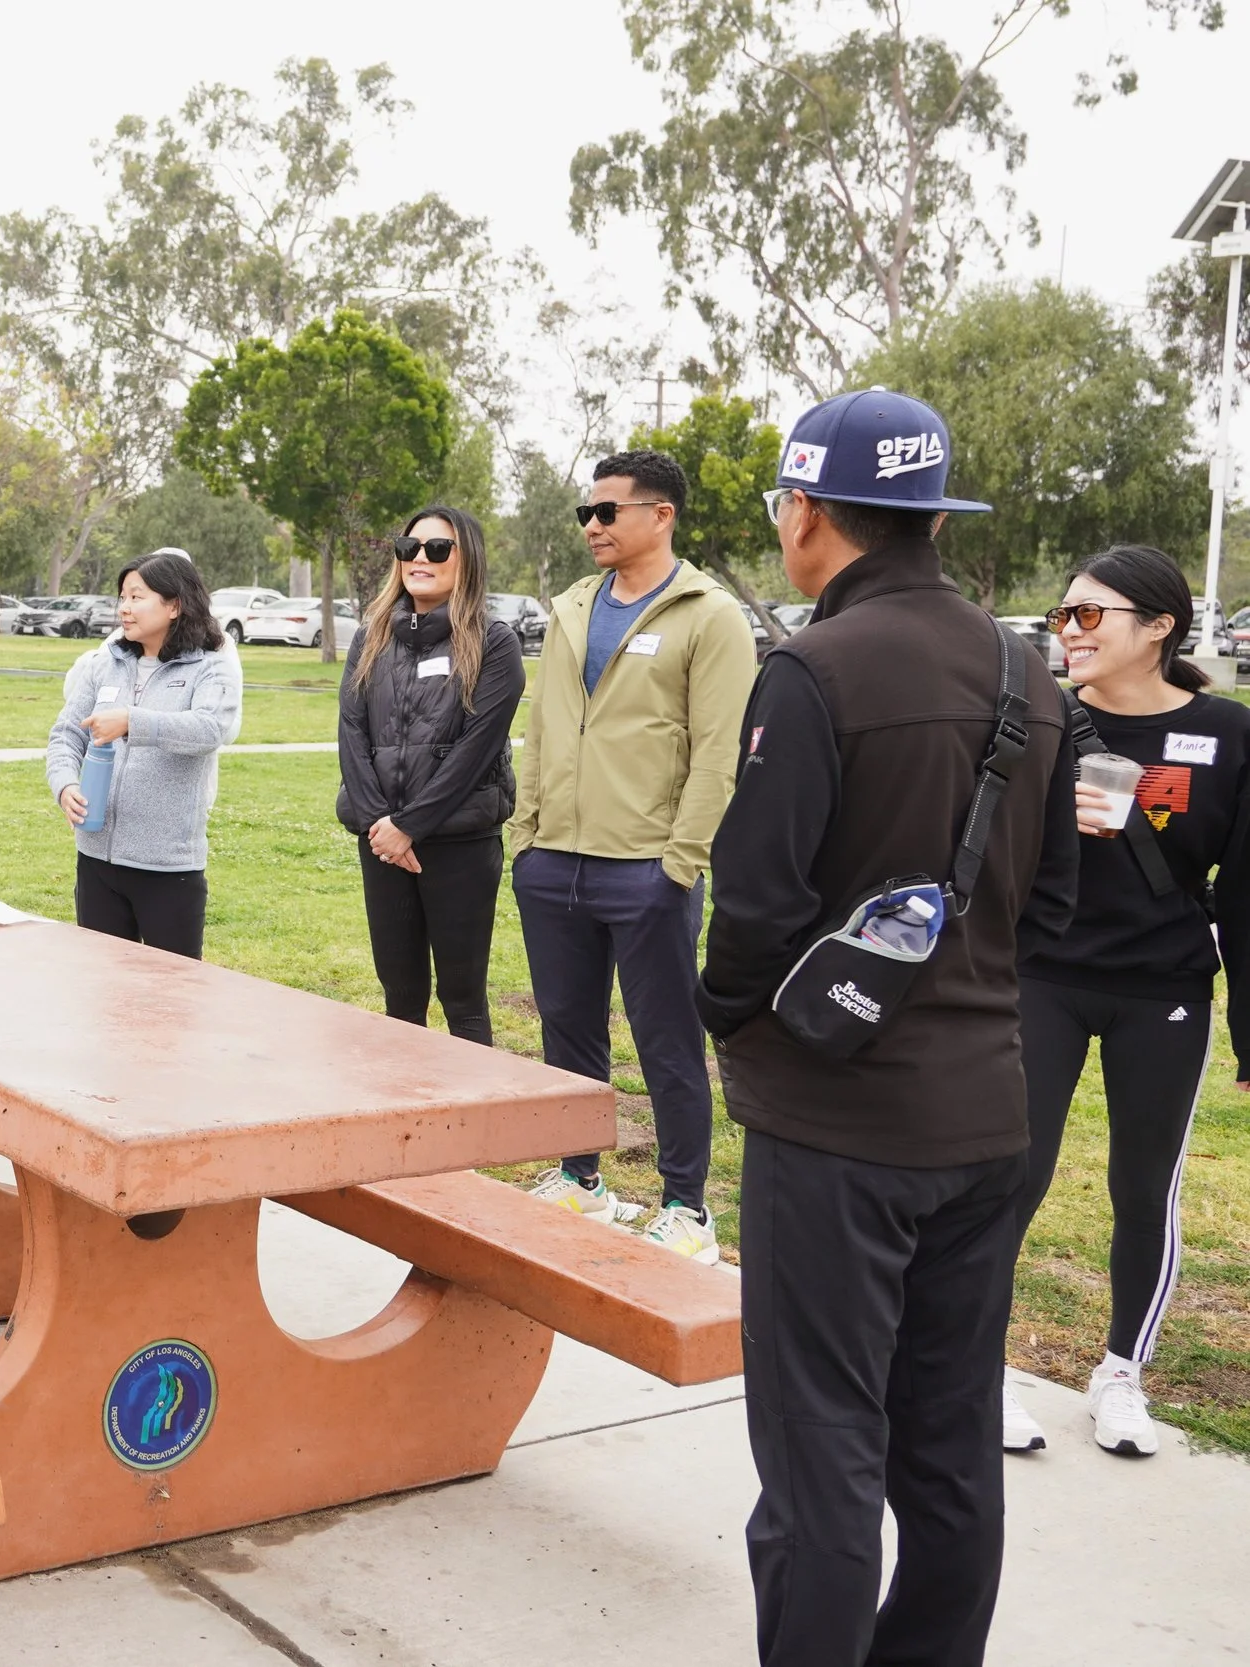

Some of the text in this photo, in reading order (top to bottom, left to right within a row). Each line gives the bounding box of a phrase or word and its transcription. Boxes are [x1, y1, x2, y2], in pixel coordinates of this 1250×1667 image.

[875, 432, 945, 480] 양키스
[1173, 739, 1207, 752] Annie
[841, 980, 881, 1013] Boston
[128, 1346, 202, 1373] CITY OF LOS ANGELES
[111, 1406, 206, 1461] DEPARTMENT OF RECREATION AND PARKS
